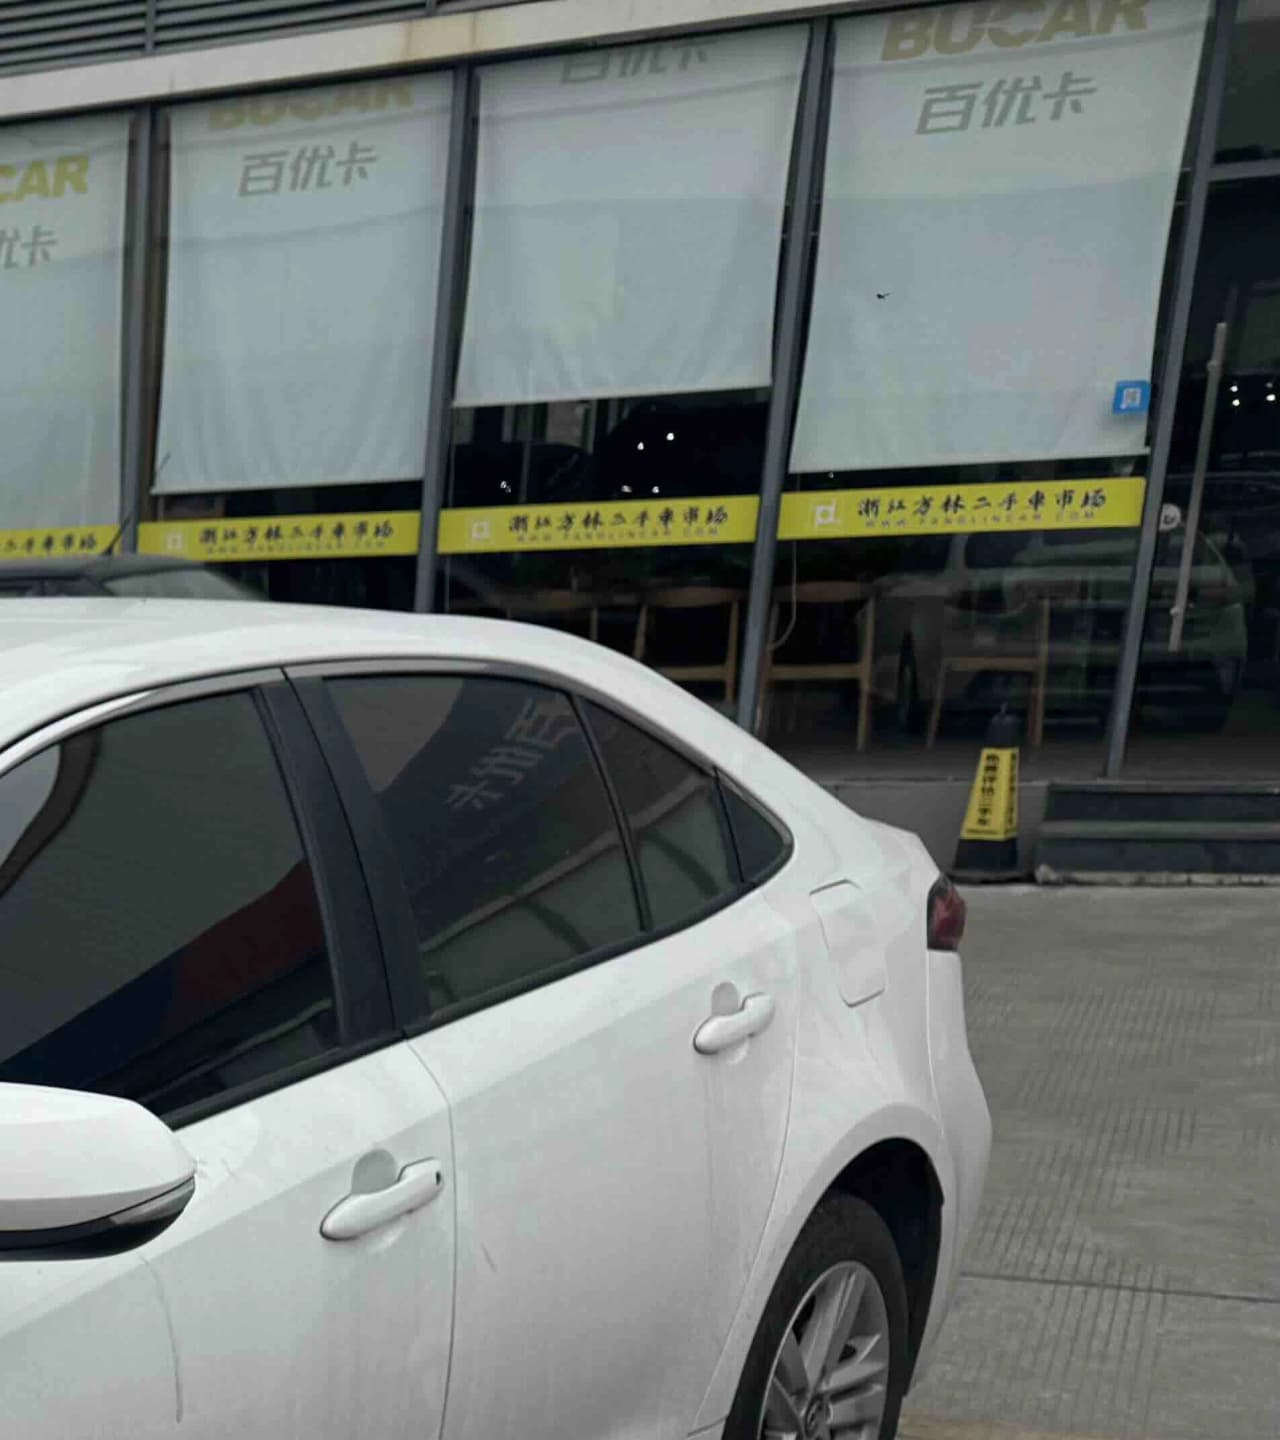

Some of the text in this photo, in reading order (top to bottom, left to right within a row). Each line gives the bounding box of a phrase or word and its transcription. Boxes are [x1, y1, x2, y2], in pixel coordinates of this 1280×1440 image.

[916, 72, 1097, 135] 百优卡
[239, 142, 378, 198] 百优卡
